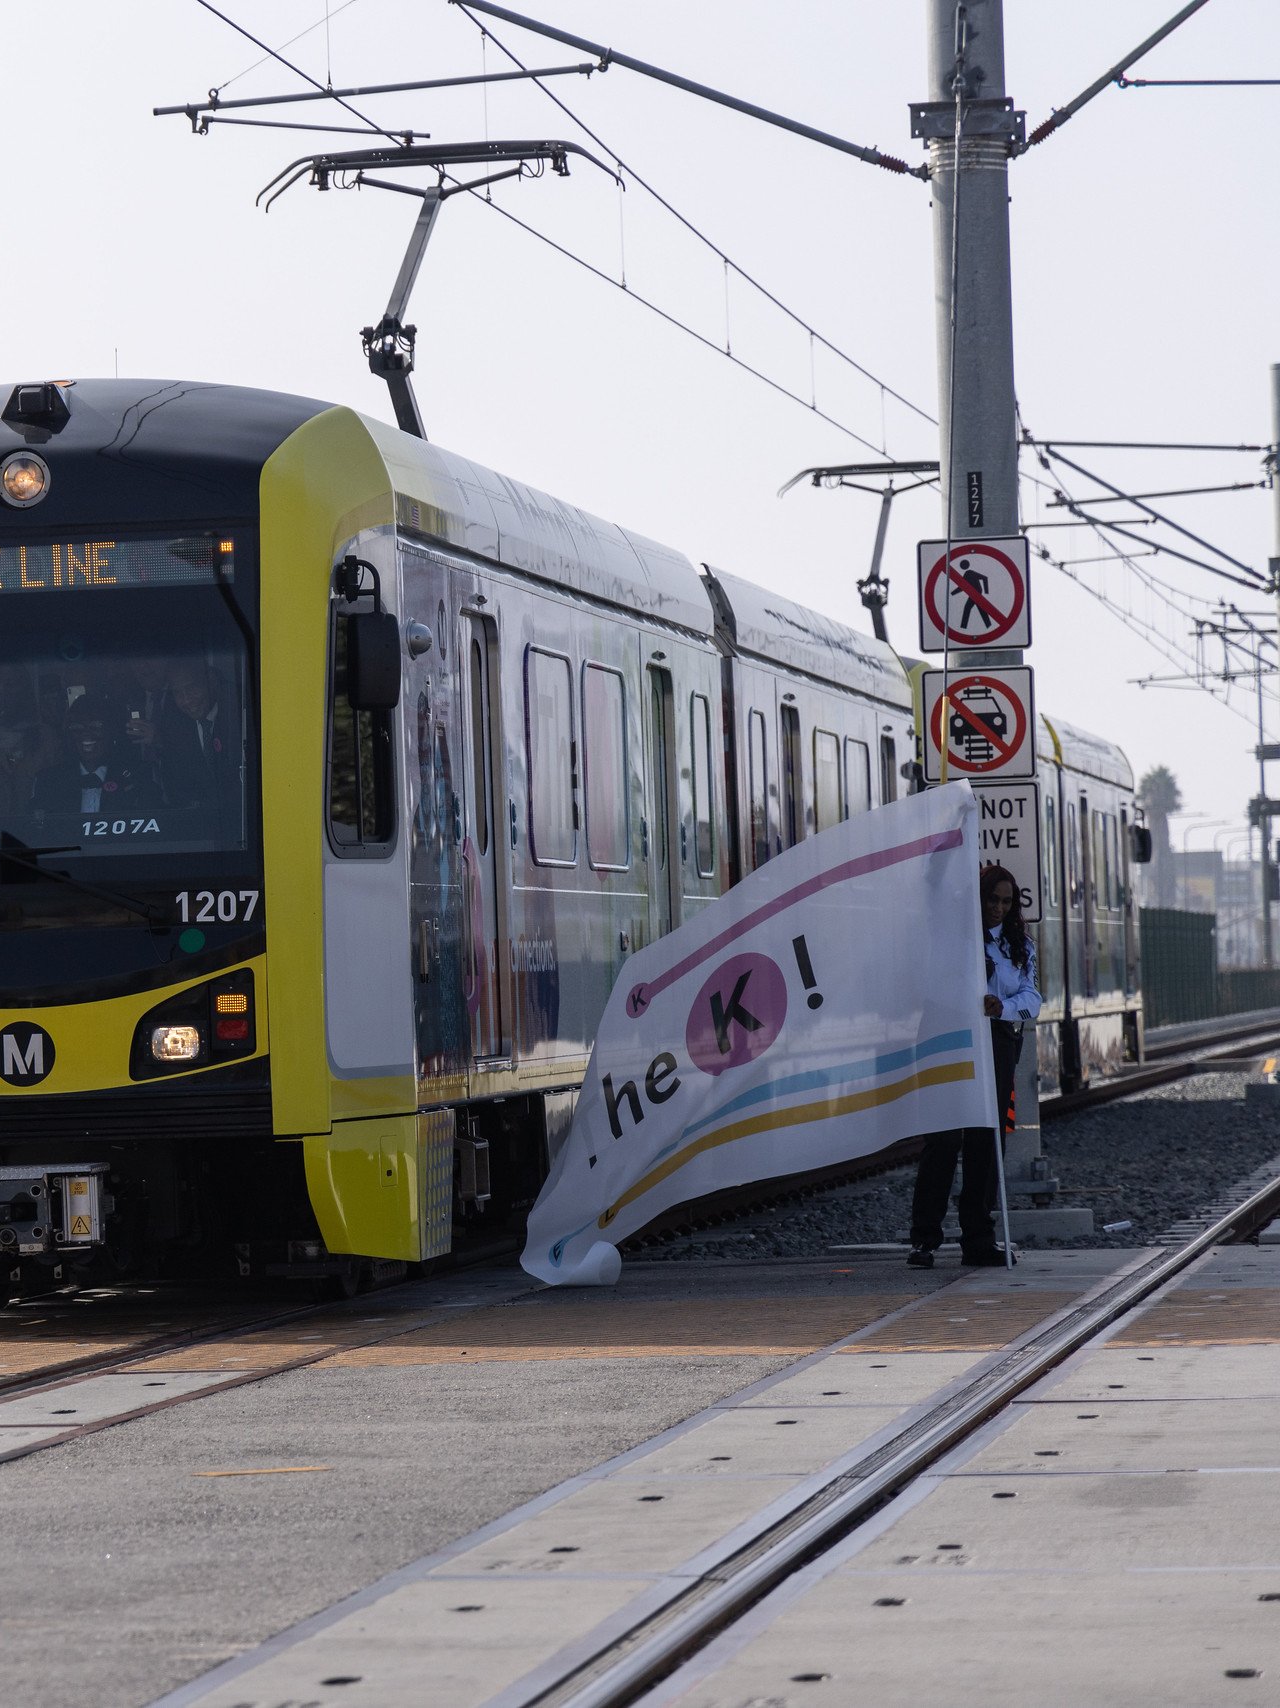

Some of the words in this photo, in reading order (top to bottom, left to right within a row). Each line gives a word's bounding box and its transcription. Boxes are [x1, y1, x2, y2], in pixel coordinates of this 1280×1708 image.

[971, 474, 980, 525] 1277
[20, 541, 117, 588] LINE
[981, 797, 1027, 819] NOT
[82, 818, 160, 836] 1207A
[979, 828, 1019, 849] IVE
[175, 890, 259, 923] 1207
[631, 986, 646, 1013] K
[2, 1033, 44, 1075] M
[588, 1051, 682, 1169] he
